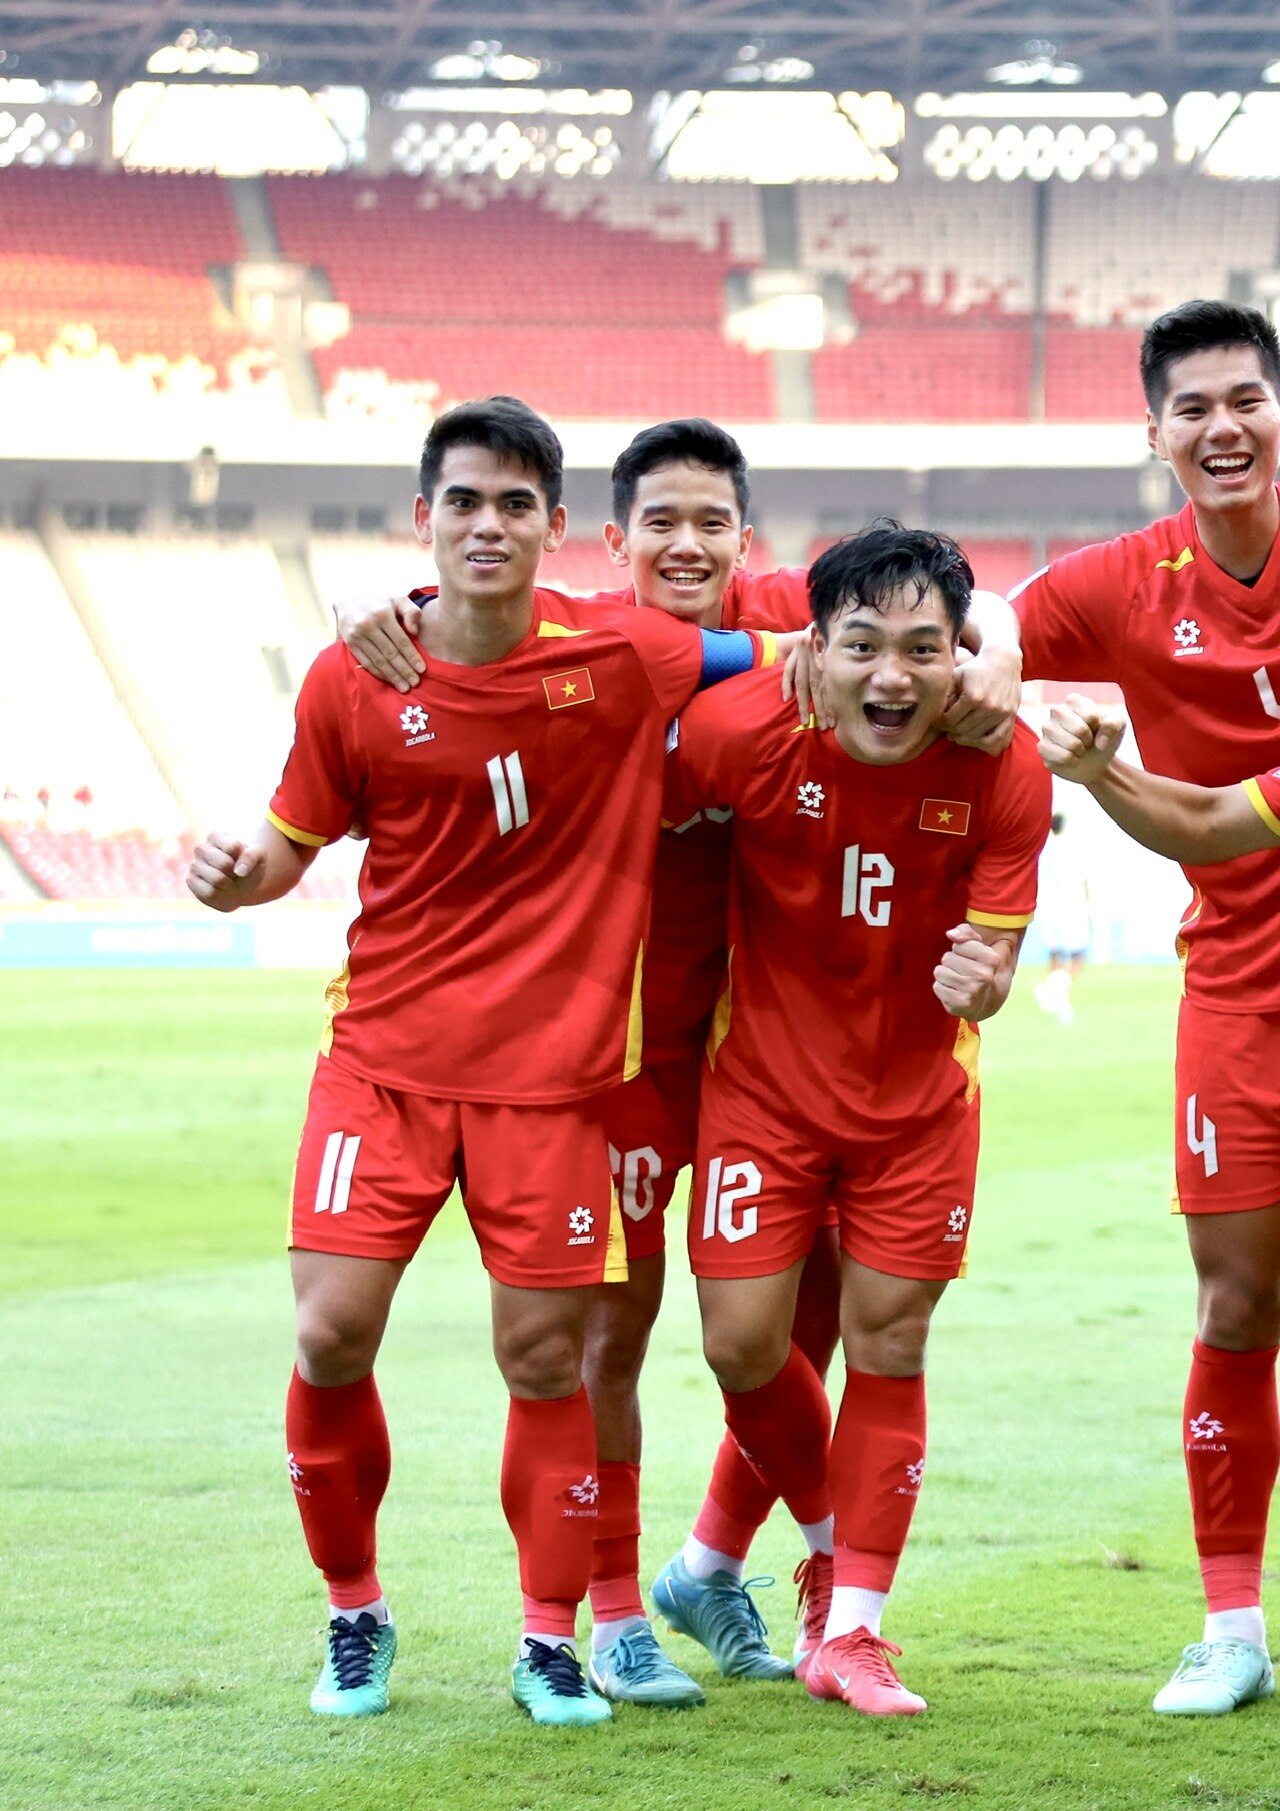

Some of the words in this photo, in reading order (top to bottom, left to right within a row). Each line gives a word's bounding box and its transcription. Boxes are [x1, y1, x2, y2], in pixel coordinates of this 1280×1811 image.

[486, 749, 530, 837] 11
[841, 843, 895, 927] 12
[314, 1130, 361, 1215] 11
[1186, 1093, 1219, 1178] 4
[702, 1156, 763, 1244] 12
